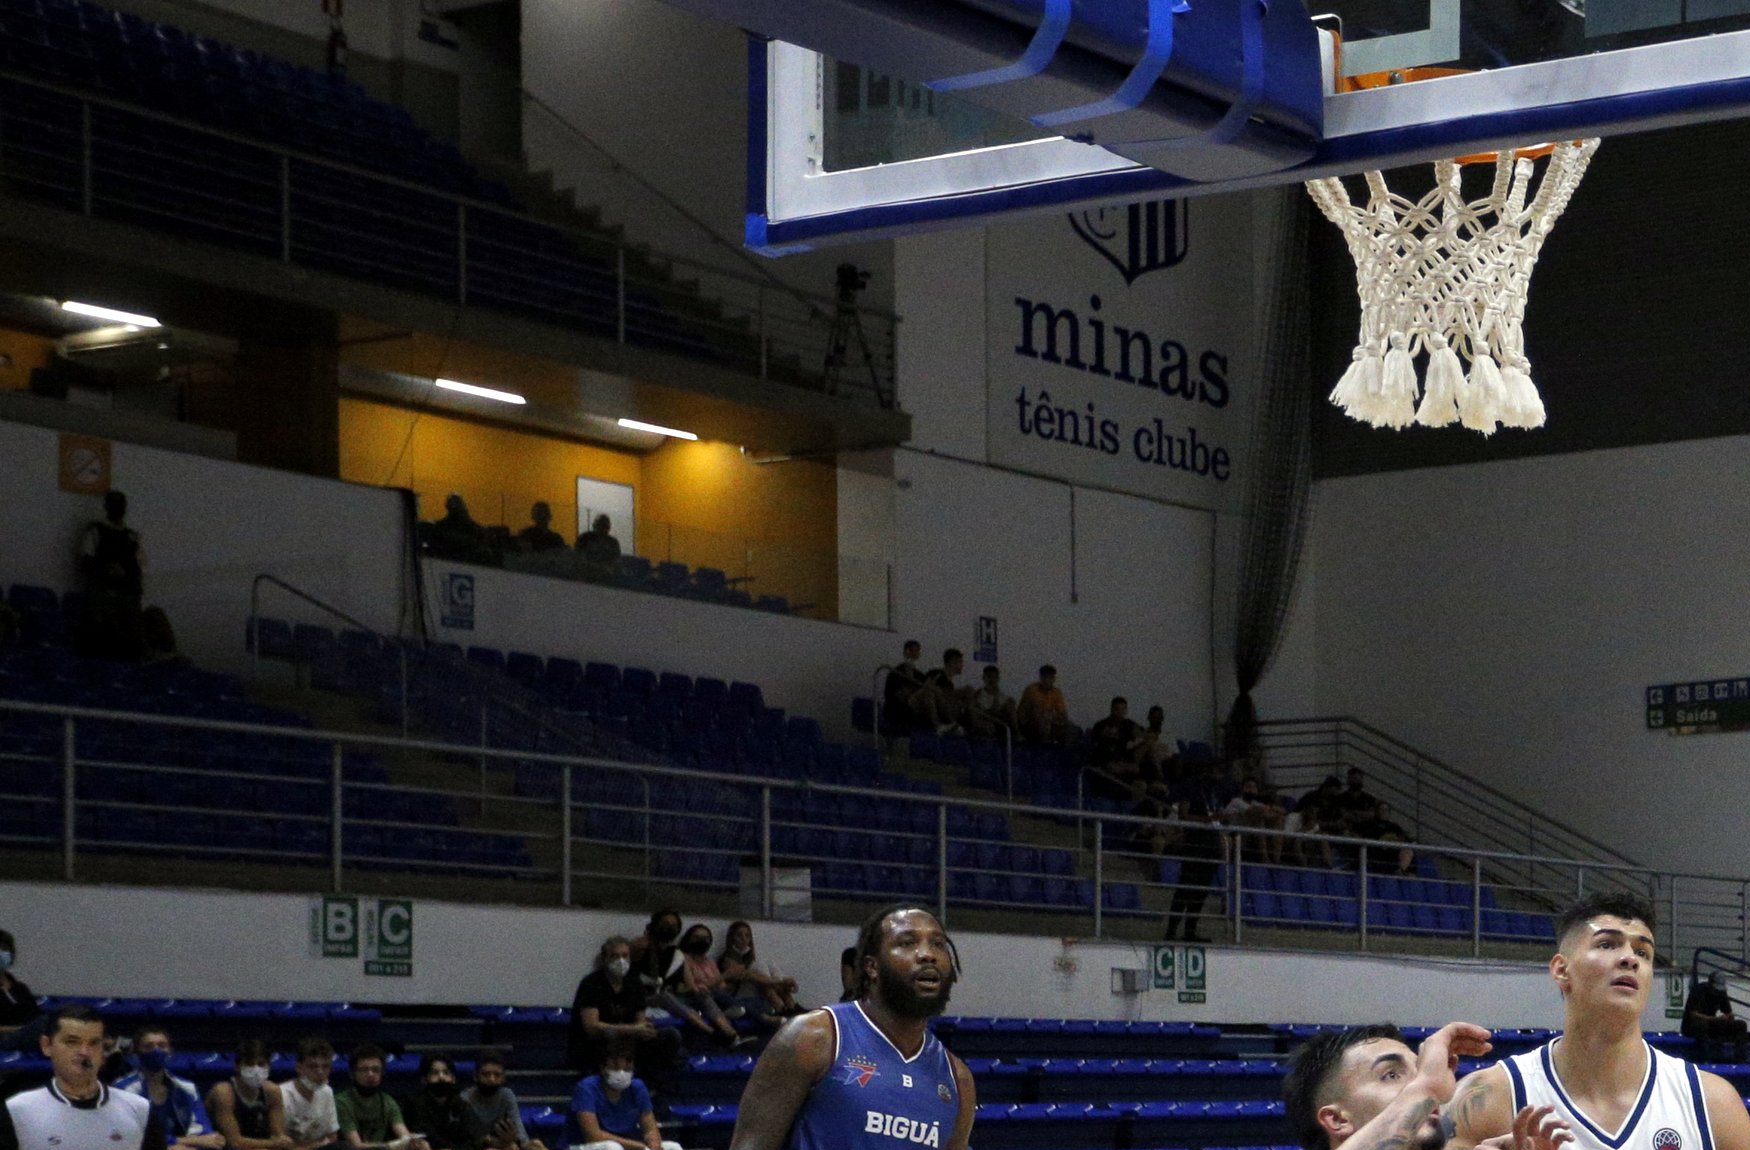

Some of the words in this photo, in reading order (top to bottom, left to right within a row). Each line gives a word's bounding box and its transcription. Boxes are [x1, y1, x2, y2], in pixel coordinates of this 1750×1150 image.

[1013, 294, 1230, 409] minas
[1014, 385, 1120, 456] tênis
[1133, 418, 1231, 482] clube
[326, 902, 354, 942] B
[381, 905, 410, 945] C
[1156, 946, 1173, 977] C
[1187, 948, 1204, 978] D
[901, 1073, 914, 1088] B
[864, 1110, 940, 1149] BIGUÁ
